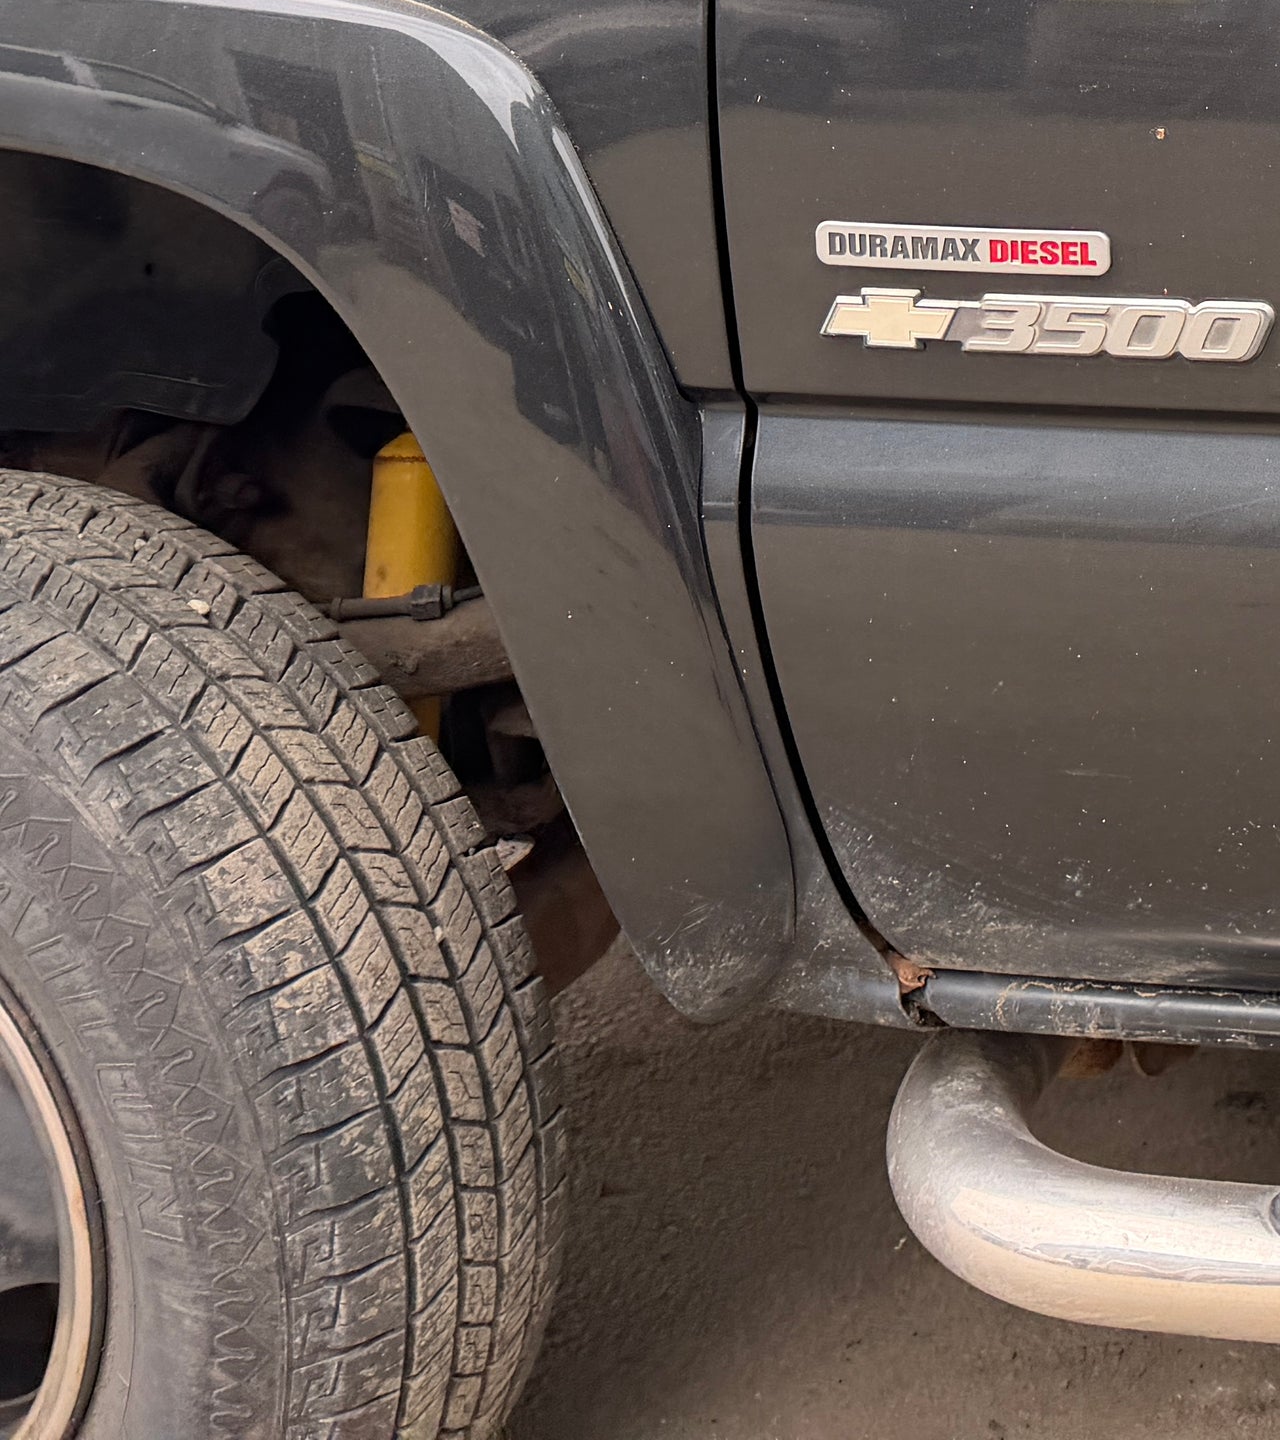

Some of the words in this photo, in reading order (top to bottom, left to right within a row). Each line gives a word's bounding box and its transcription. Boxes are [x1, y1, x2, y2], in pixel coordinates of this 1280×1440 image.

[827, 231, 982, 263] DURAMAX
[988, 238, 1098, 266] DIESEL
[964, 297, 1270, 361] 3500
